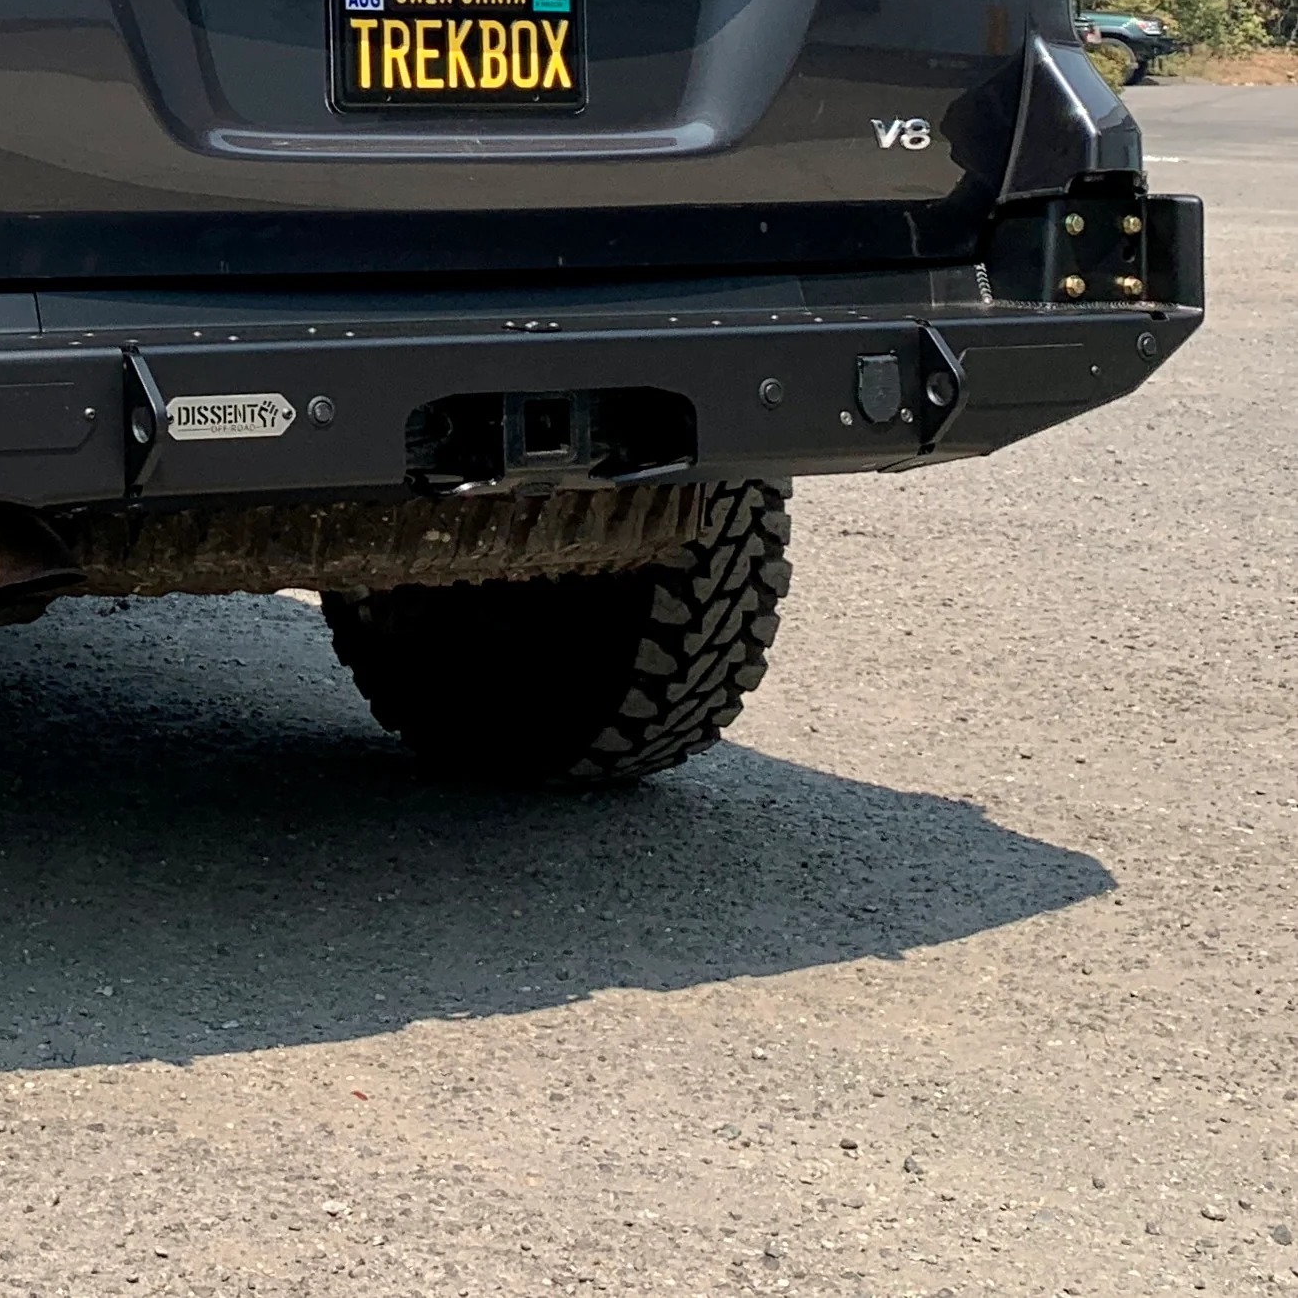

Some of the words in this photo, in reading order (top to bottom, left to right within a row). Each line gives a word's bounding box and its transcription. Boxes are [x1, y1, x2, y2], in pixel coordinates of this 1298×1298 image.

[350, 19, 571, 89] TREKBOX
[870, 118, 931, 150] V8
[177, 404, 259, 426] DISSENT
